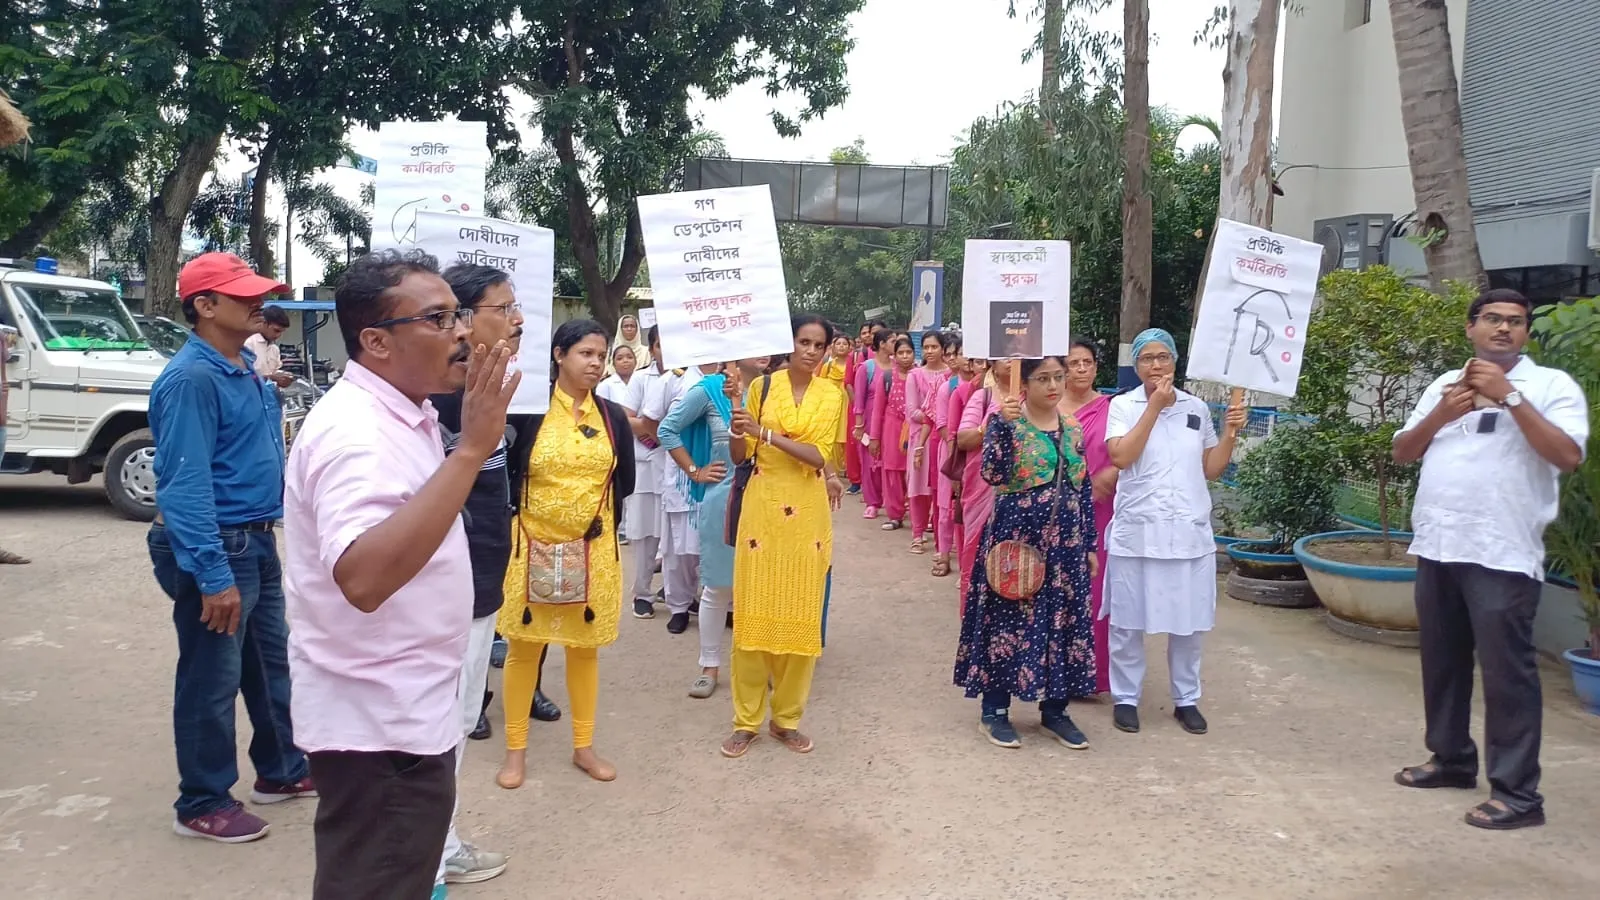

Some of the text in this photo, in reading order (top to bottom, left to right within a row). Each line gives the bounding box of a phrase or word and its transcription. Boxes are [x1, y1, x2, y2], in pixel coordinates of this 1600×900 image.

[410, 142, 450, 157] প্রতীকি
[401, 161, 457, 175] কর্মবিরতি
[694, 198, 716, 211] গণ
[459, 225, 520, 248] দোষীদের
[673, 218, 743, 238] ডেপুটেশন
[683, 245, 740, 263] দোষীদের
[1246, 235, 1285, 256] প্রতীকি
[990, 246, 1048, 265] স্বাস্থ্যকর্মী
[685, 267, 742, 283] অবিলম্বে
[1236, 256, 1288, 279] কর্মবিরতি
[1000, 272, 1038, 288] সুরক্ষা
[683, 293, 752, 315] দৃষ্টান্তমূলক
[691, 312, 752, 333] শাস্তি চাই
